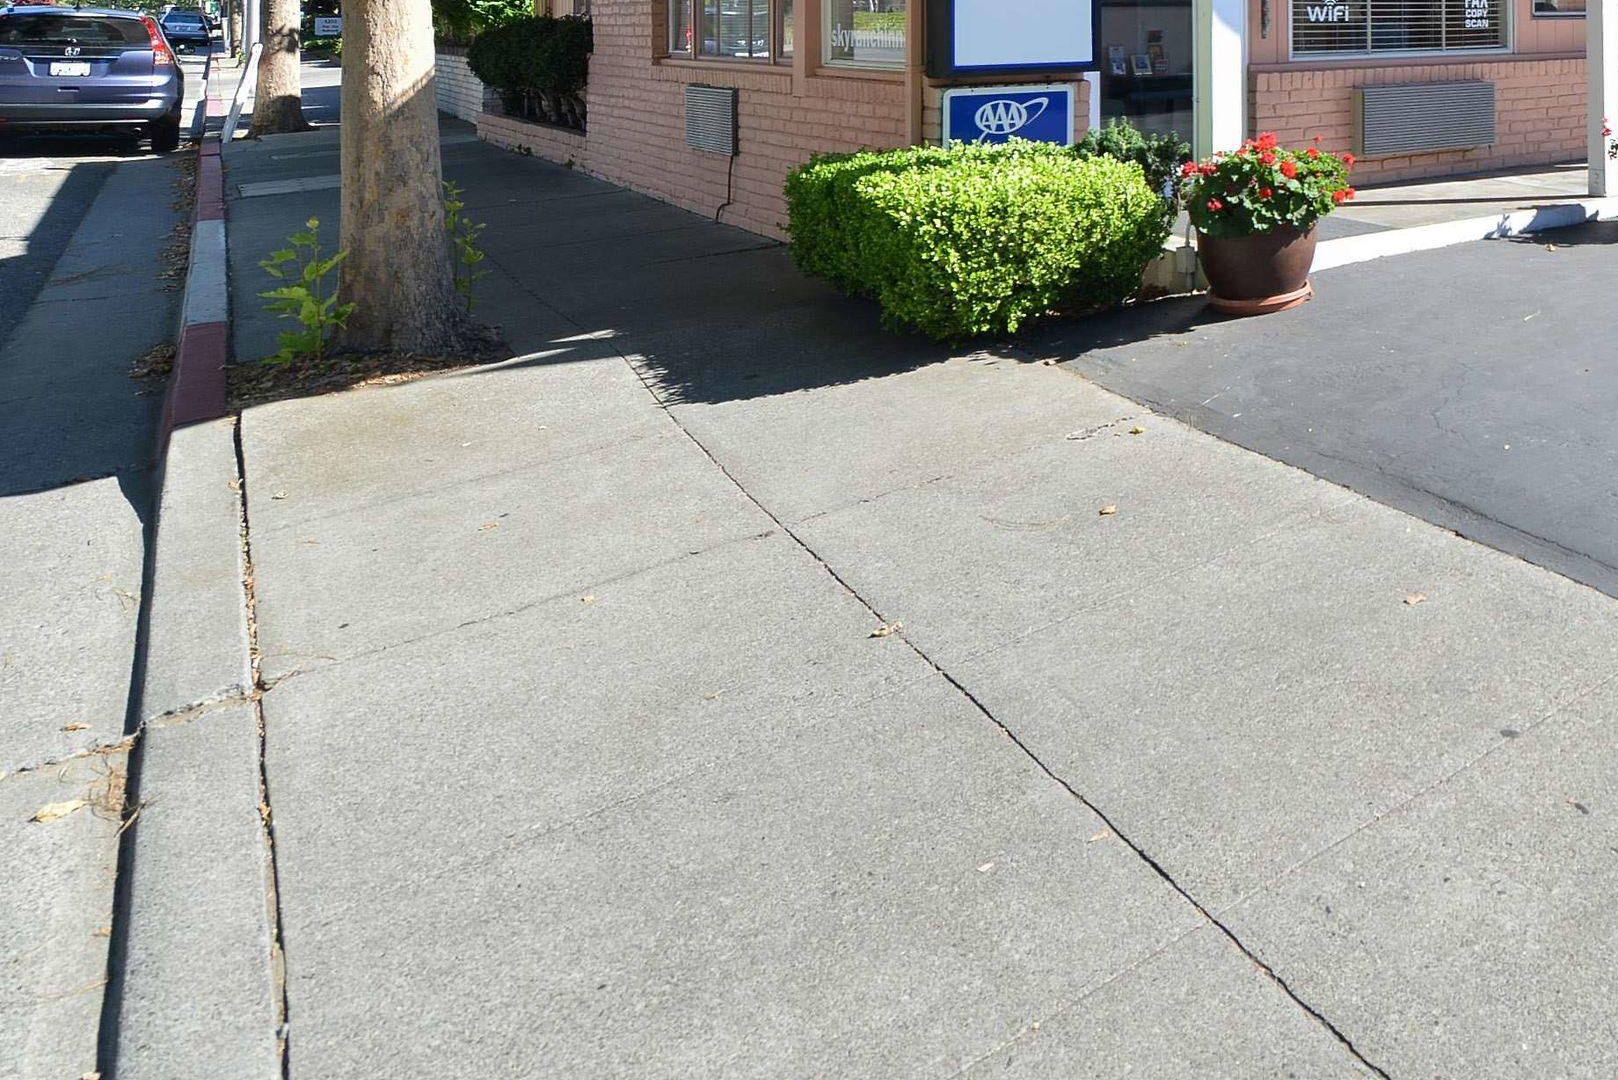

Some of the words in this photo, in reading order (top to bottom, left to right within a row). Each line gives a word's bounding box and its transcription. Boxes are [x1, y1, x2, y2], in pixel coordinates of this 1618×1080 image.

[1306, 5, 1350, 22] WiFi
[1465, 9, 1489, 18] COPY
[1465, 19, 1489, 28] SCAN
[980, 101, 1025, 133] AAA
